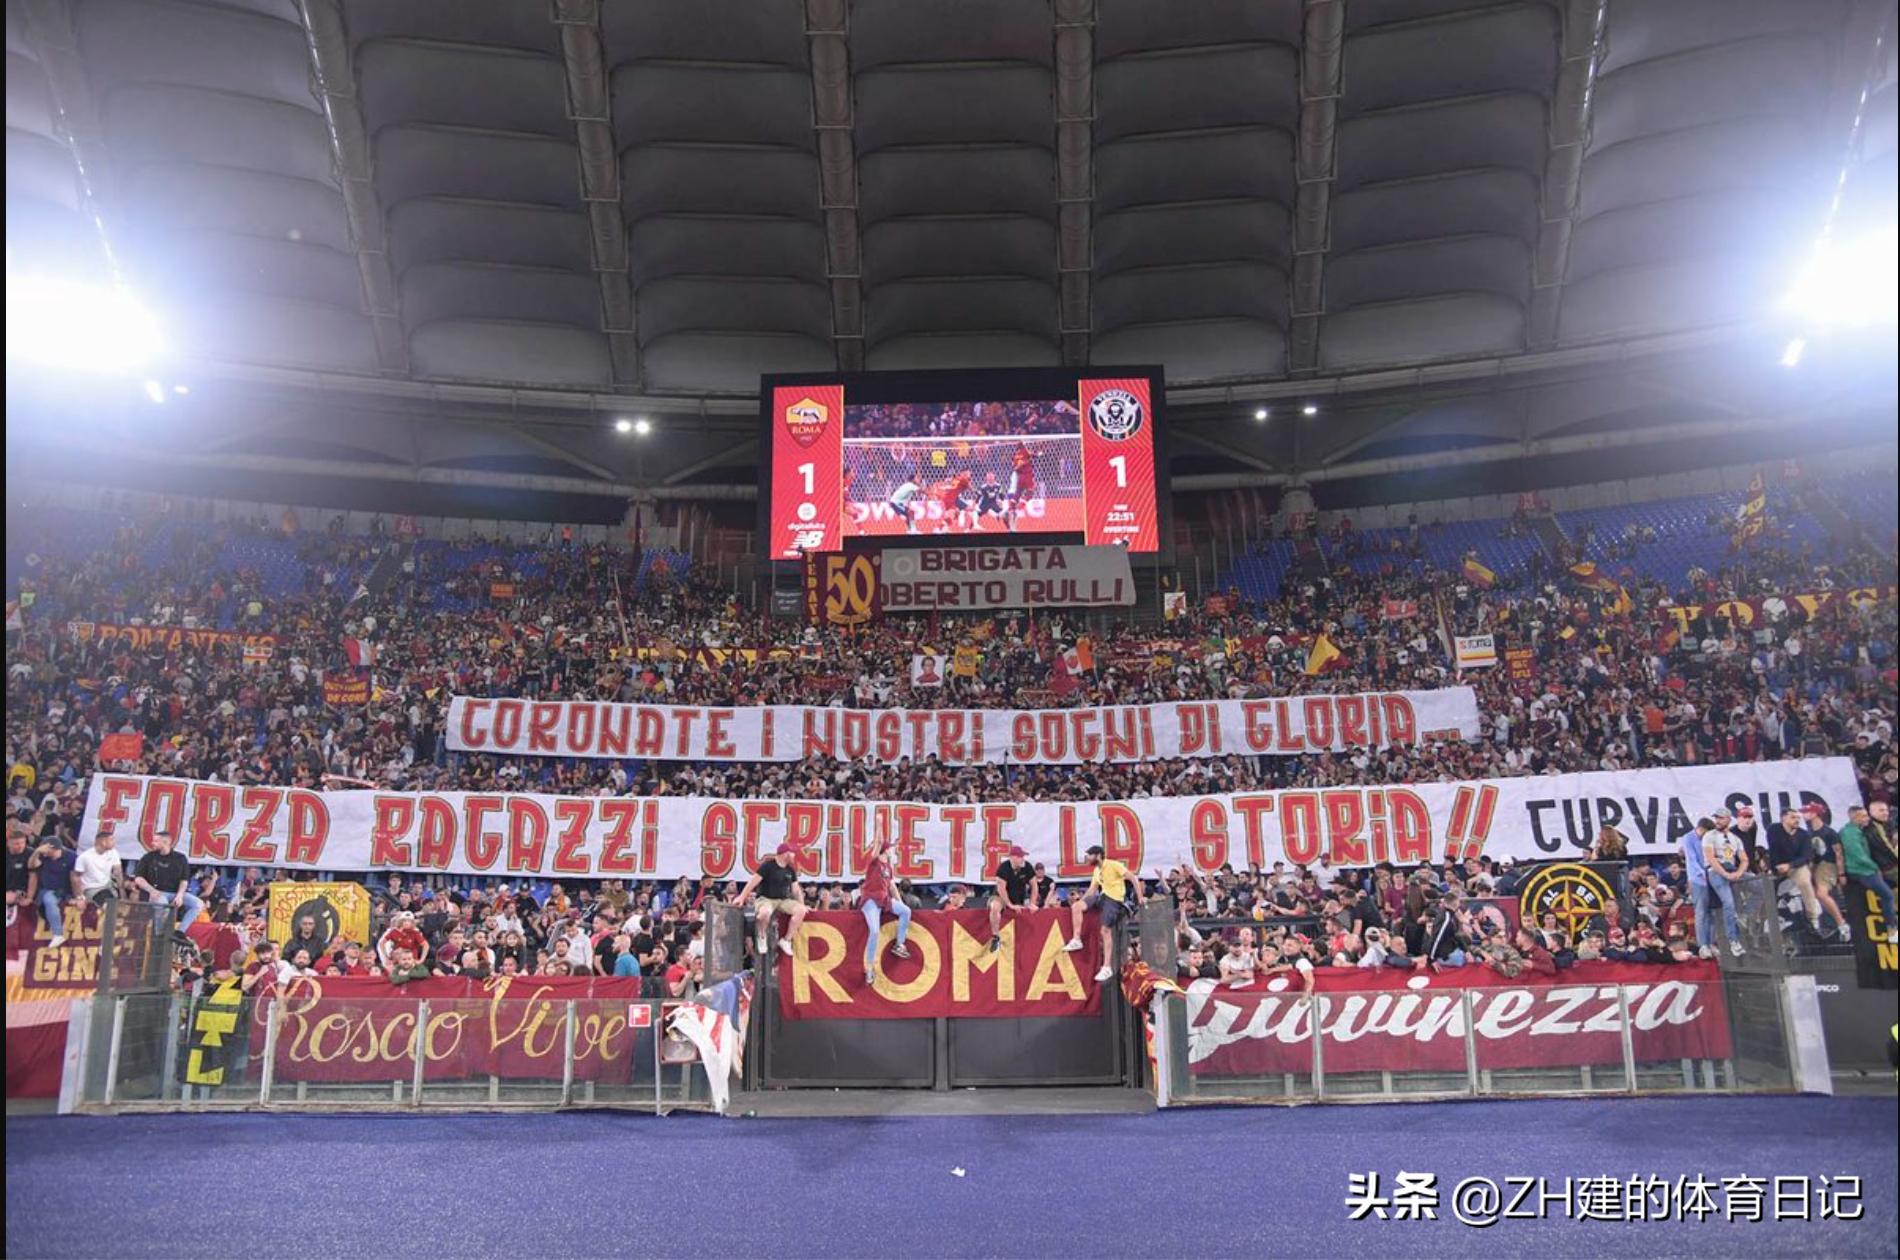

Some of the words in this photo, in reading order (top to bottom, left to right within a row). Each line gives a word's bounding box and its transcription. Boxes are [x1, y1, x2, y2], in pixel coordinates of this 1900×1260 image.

[791, 425, 822, 435] ROMA
[798, 463, 815, 495] 1
[1109, 456, 1126, 488] 1
[920, 547, 1067, 572] BRIGATA
[1023, 578, 1123, 604] RULLI
[460, 698, 735, 758] CORONATE
[760, 708, 775, 758] I
[803, 708, 984, 763] NOSTRI
[1012, 707, 1156, 762] SOGNI
[1176, 702, 1222, 754] DI
[99, 776, 331, 864] FORZA
[371, 796, 661, 873] RAGAZZI
[701, 801, 1018, 882] SCRIVETE
[1057, 802, 1146, 882] LA
[1525, 796, 1694, 853] CURVA
[791, 919, 1087, 1004] ROMA
[483, 975, 626, 1061] Vive
[1186, 977, 1704, 1065] Giovinezza
